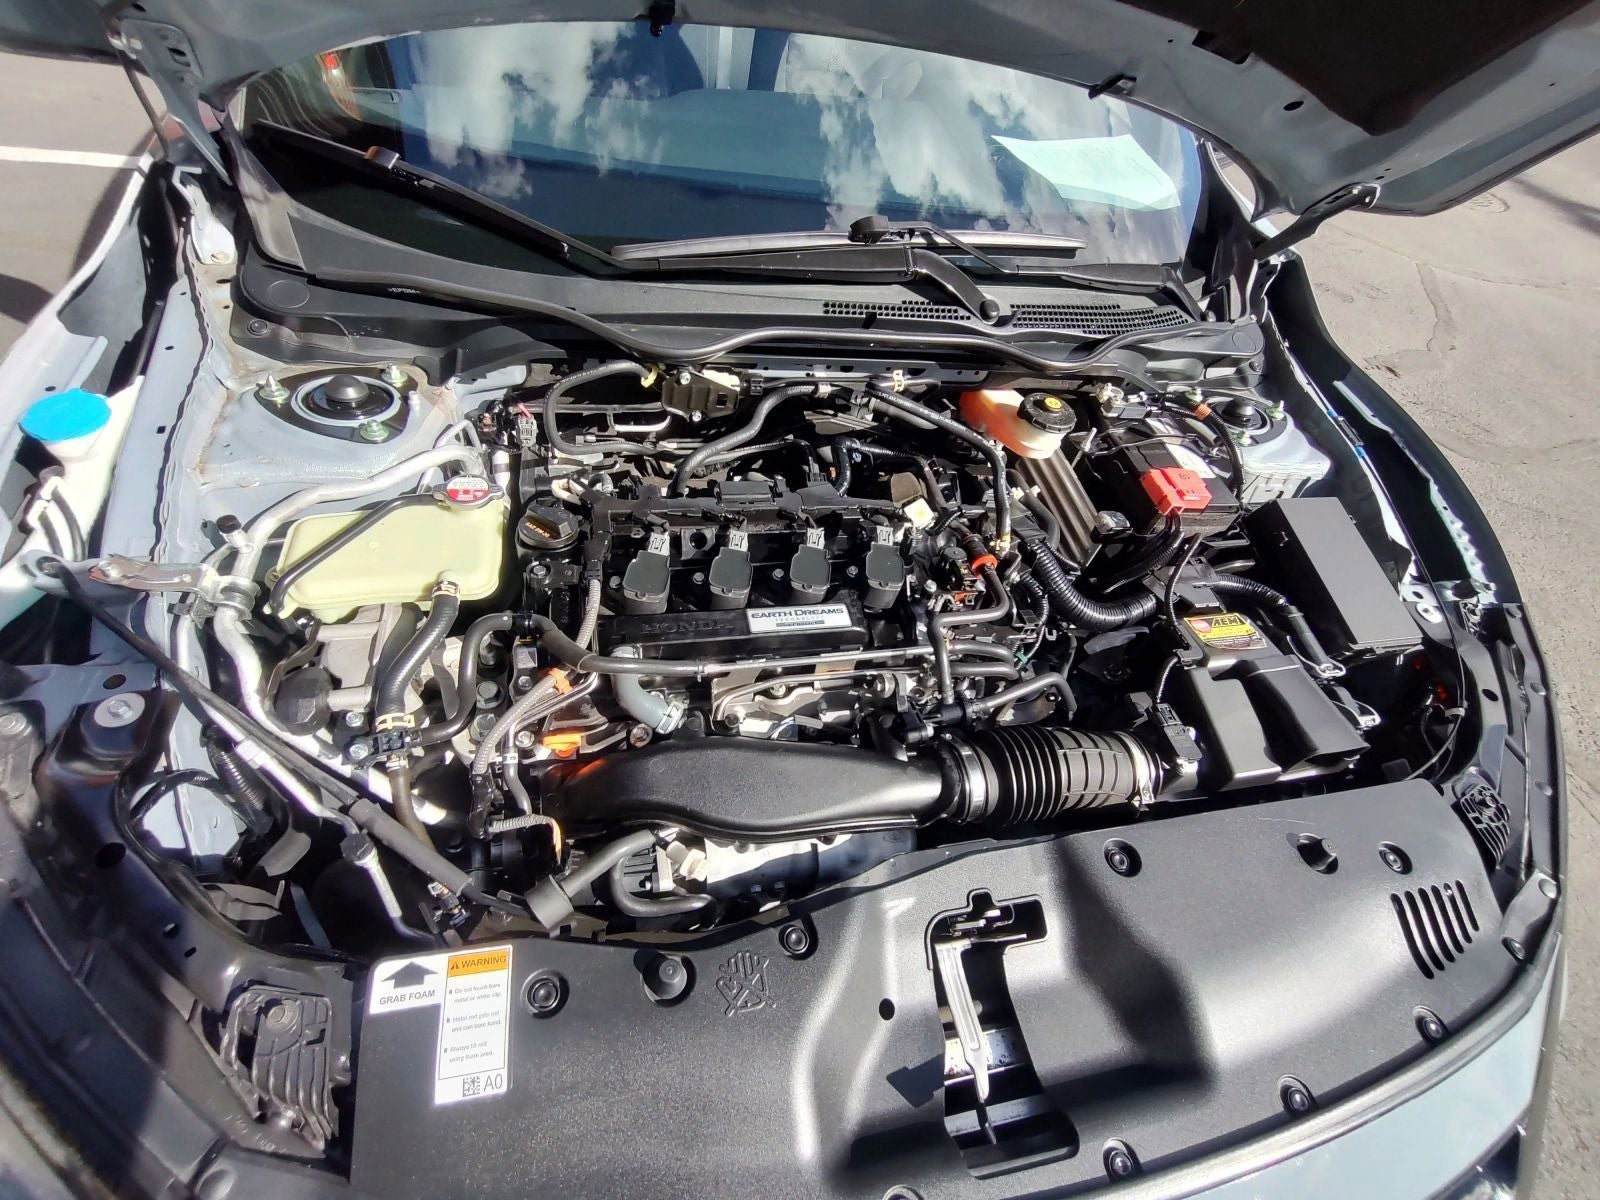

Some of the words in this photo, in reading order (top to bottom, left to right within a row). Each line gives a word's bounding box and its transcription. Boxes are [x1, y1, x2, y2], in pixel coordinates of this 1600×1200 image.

[751, 610, 792, 619] EARTH
[794, 607, 844, 617] DREAMS
[640, 619, 735, 634] HONDA
[1213, 616, 1241, 627] AEM
[461, 955, 507, 969] WARNING
[379, 993, 406, 1005] GRAB
[408, 989, 436, 1002] FOAM
[476, 992, 491, 1000] white
[449, 1043, 469, 1053] Always
[483, 1073, 503, 1092] A0
